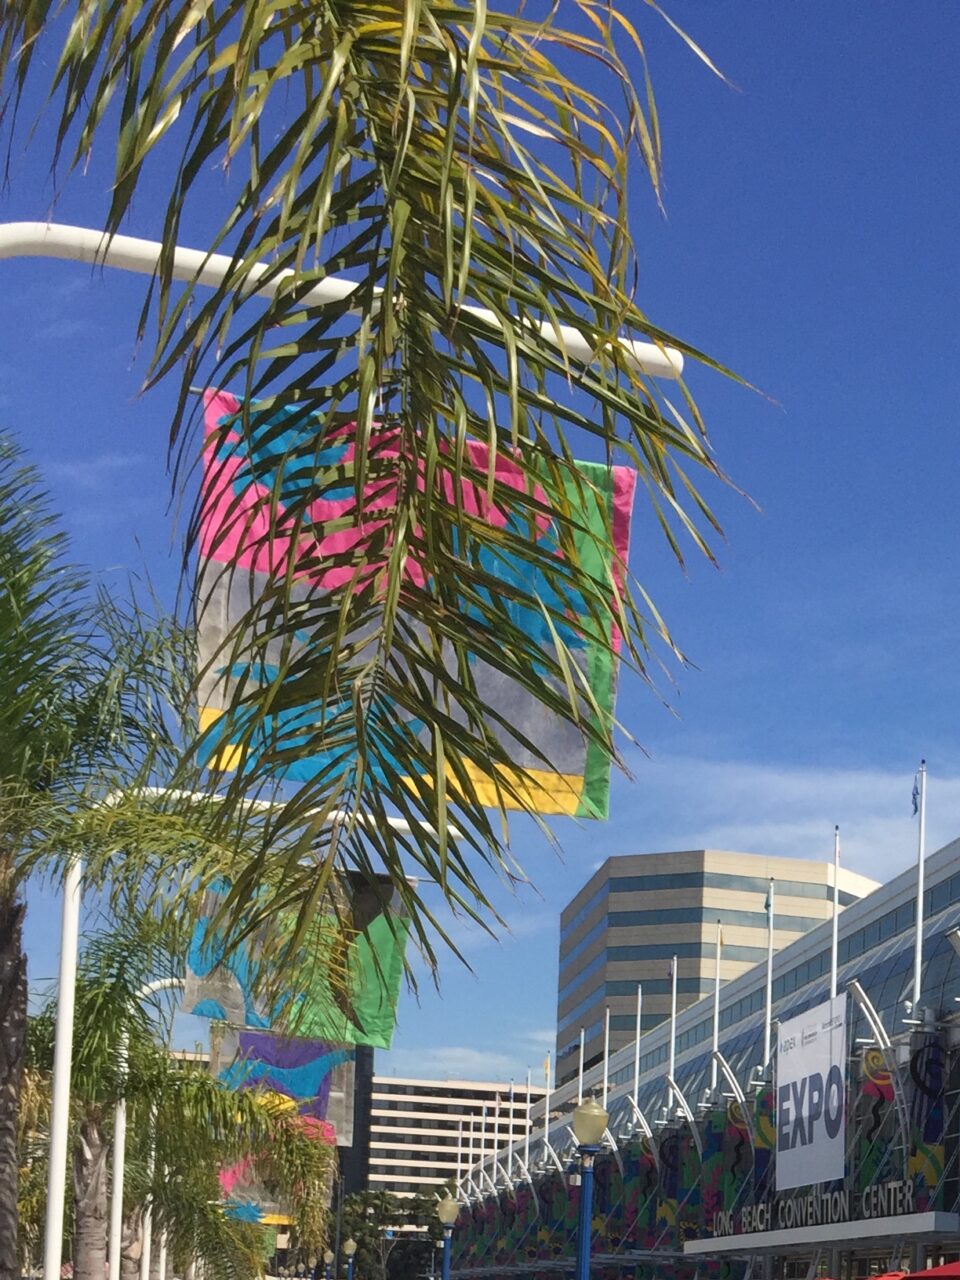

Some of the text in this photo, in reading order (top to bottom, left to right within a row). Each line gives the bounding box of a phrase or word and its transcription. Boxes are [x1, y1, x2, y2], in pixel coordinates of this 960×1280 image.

[778, 1065, 843, 1152] EXPO
[713, 1180, 914, 1237] LONG BEACH CONVENTION CENTER
